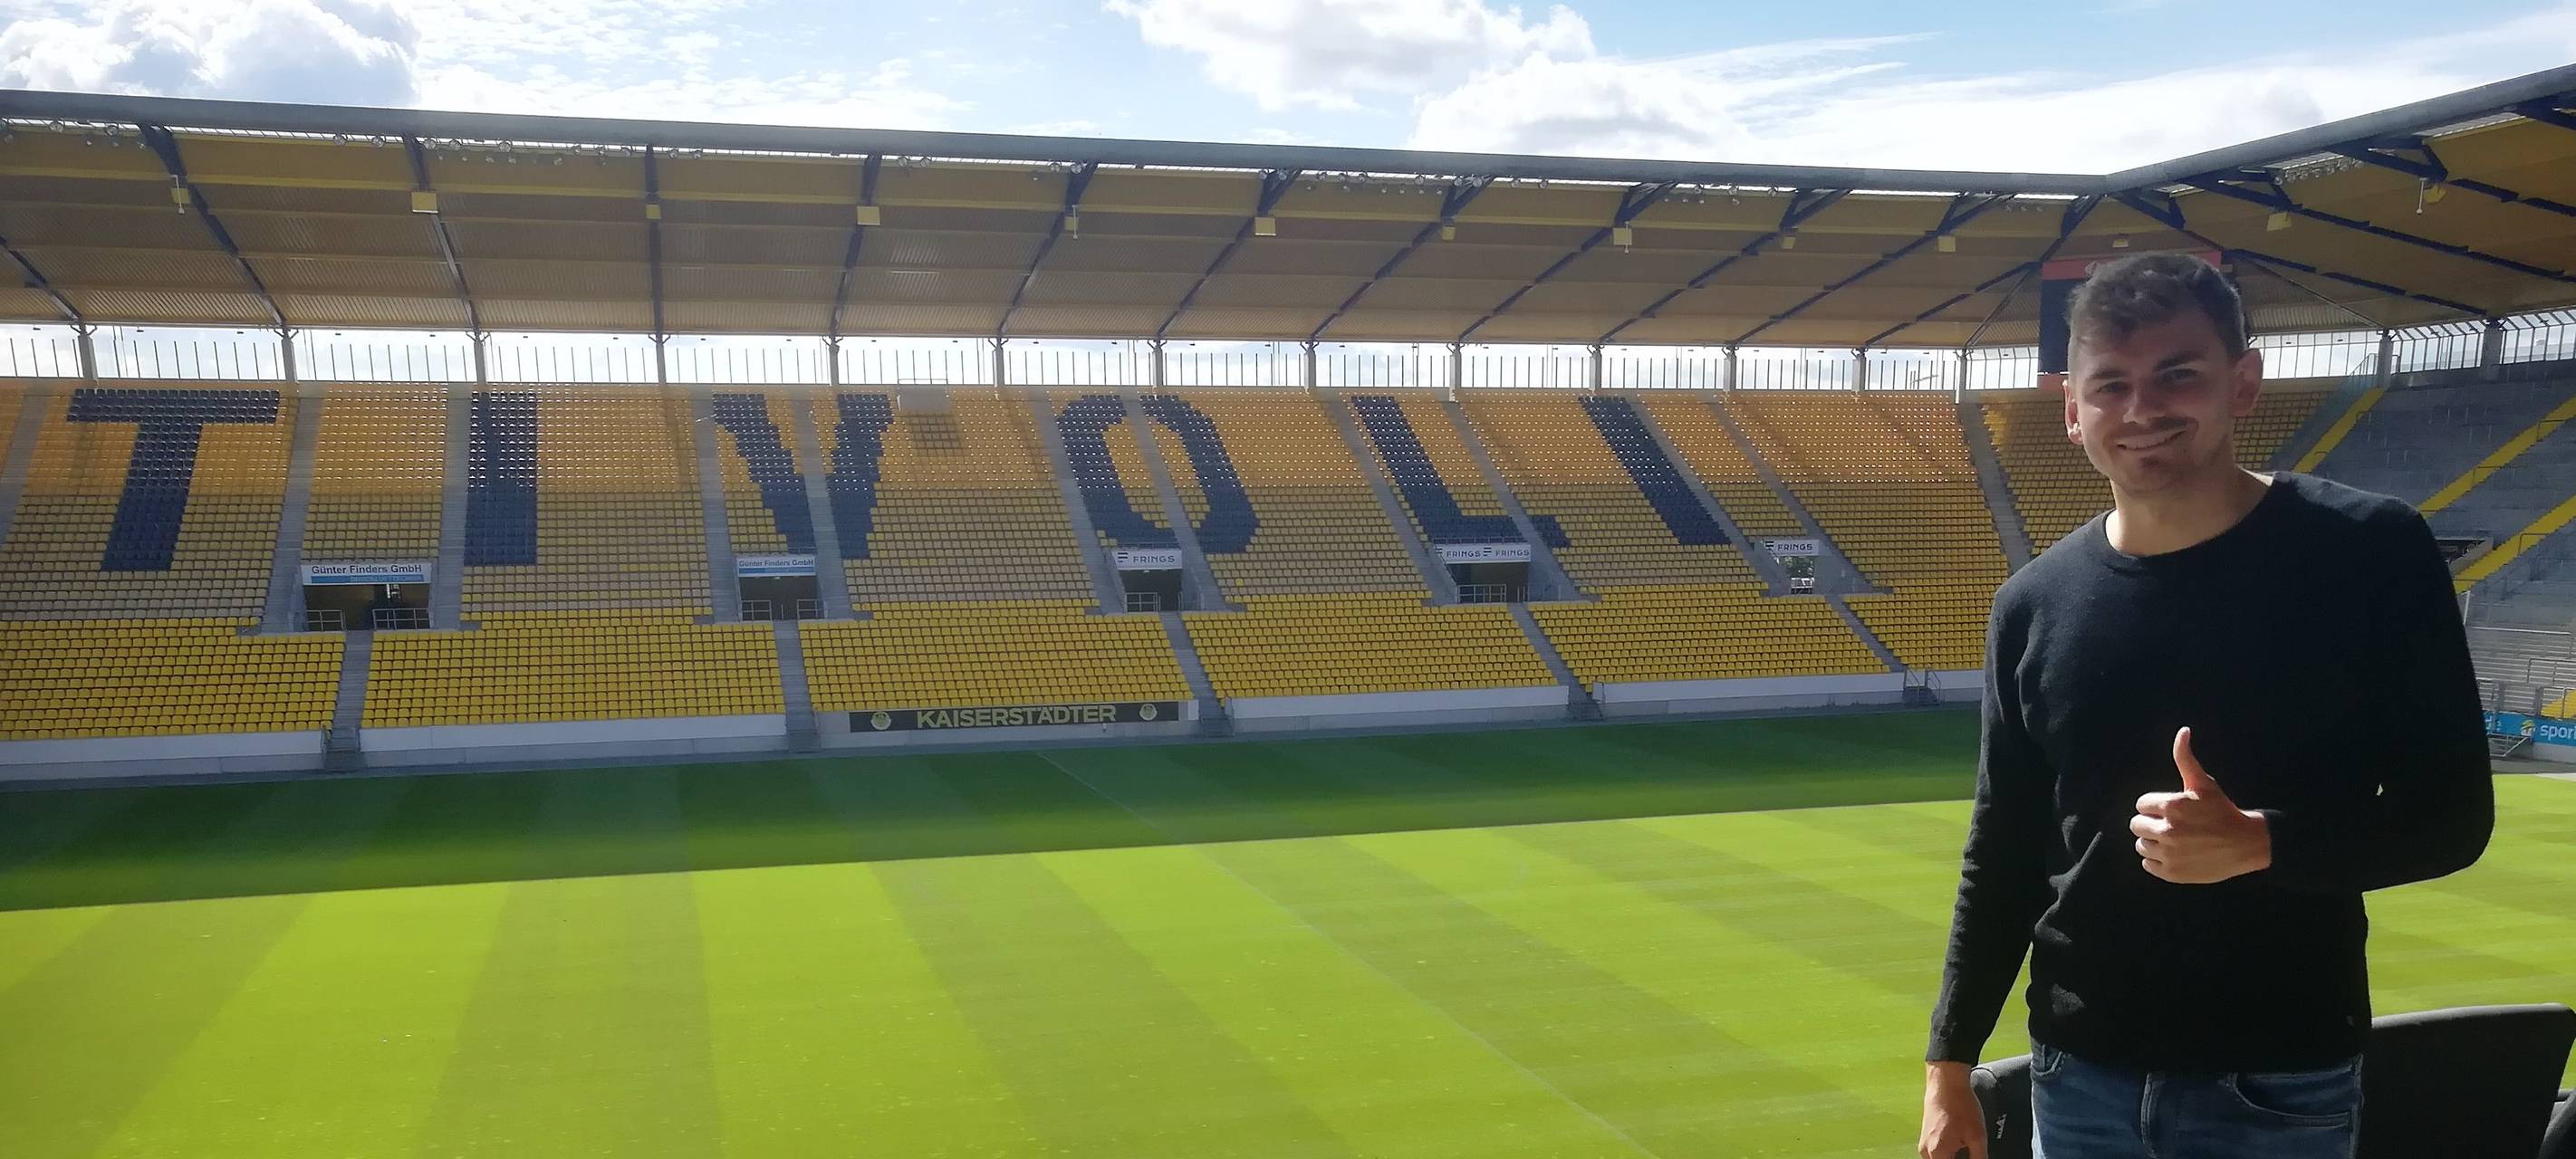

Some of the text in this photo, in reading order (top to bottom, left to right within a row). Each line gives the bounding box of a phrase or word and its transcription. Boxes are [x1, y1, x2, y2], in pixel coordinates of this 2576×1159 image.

[67, 388, 1731, 570] TIVOLI
[1495, 549, 1530, 557] FRINGS
[1132, 555, 1176, 563] FRINGS
[311, 563, 423, 574] Günter Finders GmbH
[916, 704, 1117, 729] KAISERSTÄDTER
